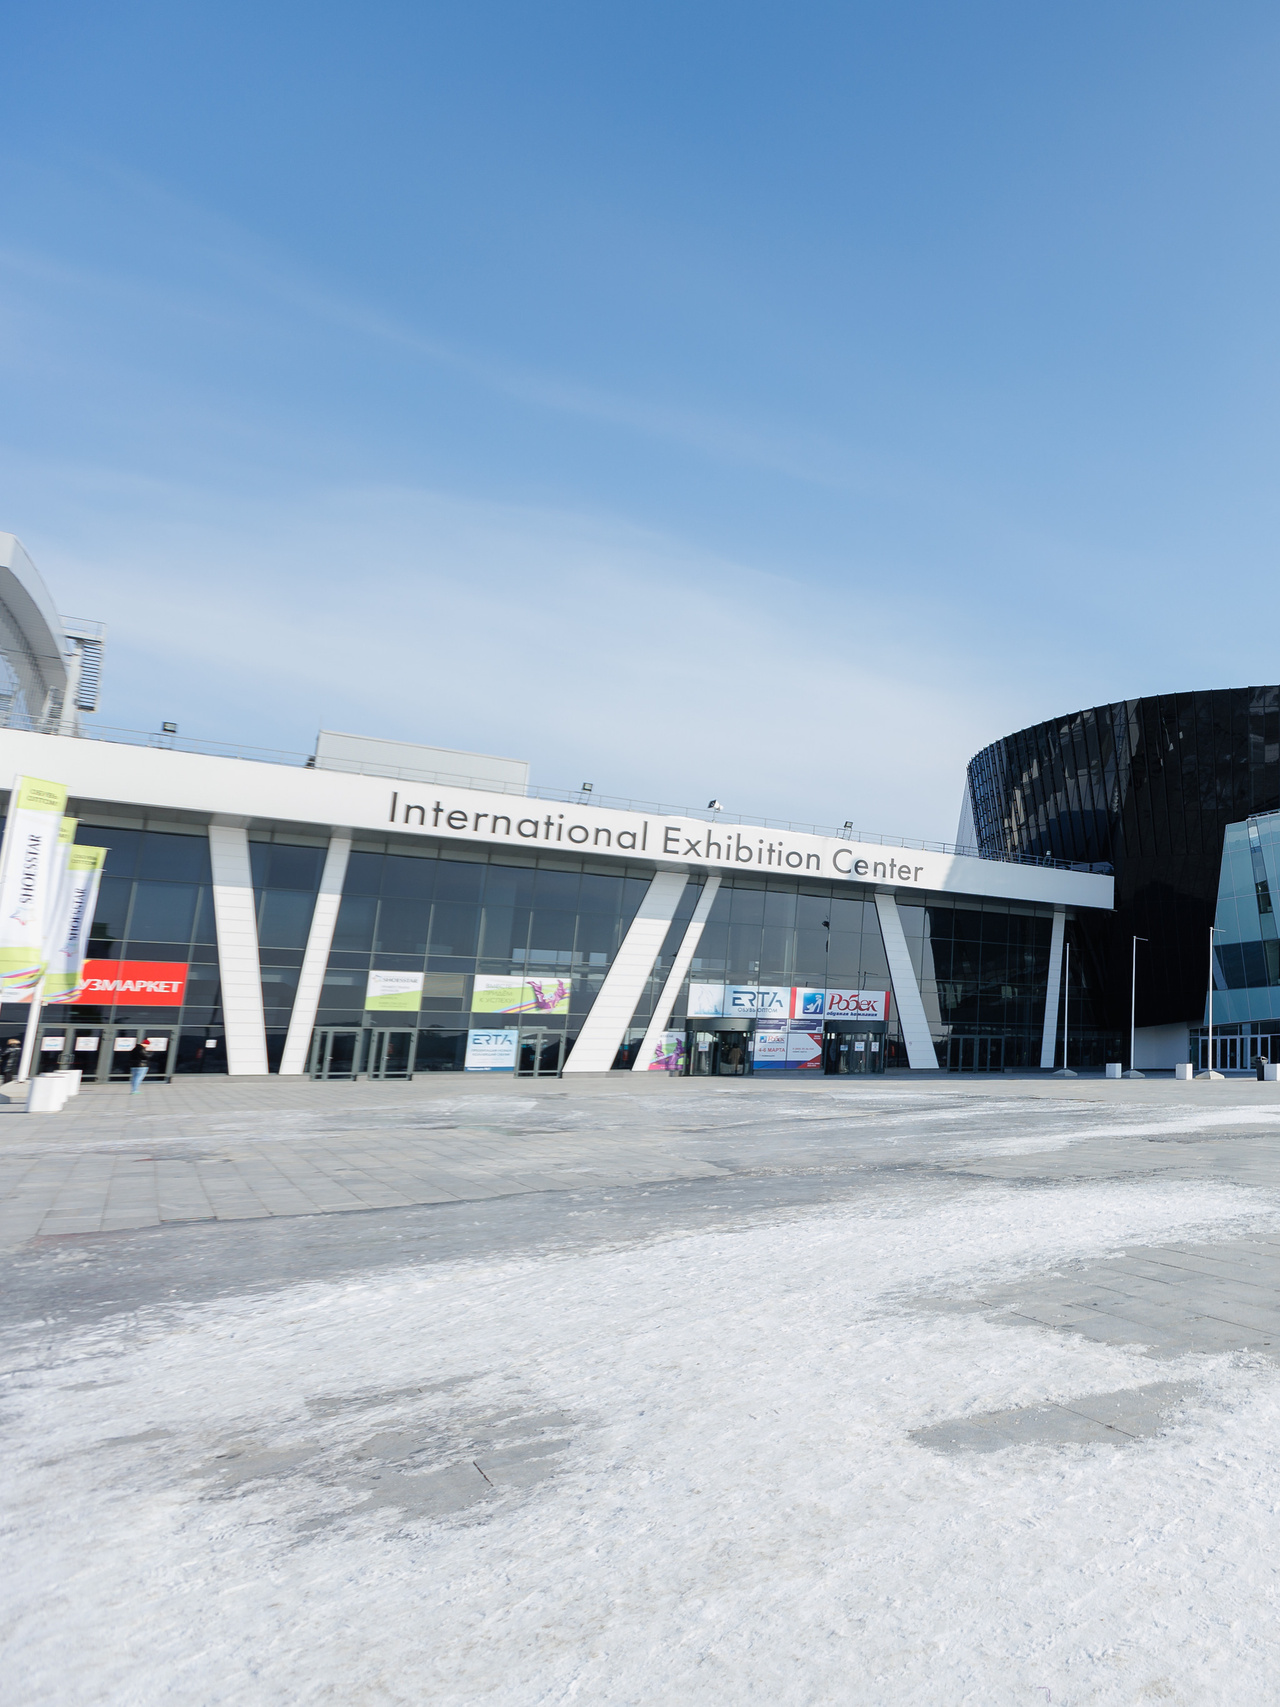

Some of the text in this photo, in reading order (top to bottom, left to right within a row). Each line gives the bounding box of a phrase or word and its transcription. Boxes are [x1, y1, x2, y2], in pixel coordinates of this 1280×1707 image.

[389, 791, 924, 882] International Exhibition Center
[19, 833, 42, 904] SHOESSTAR
[732, 990, 783, 1008] ERTA
[828, 992, 879, 1012] Робек
[472, 1034, 512, 1045] ERTA
